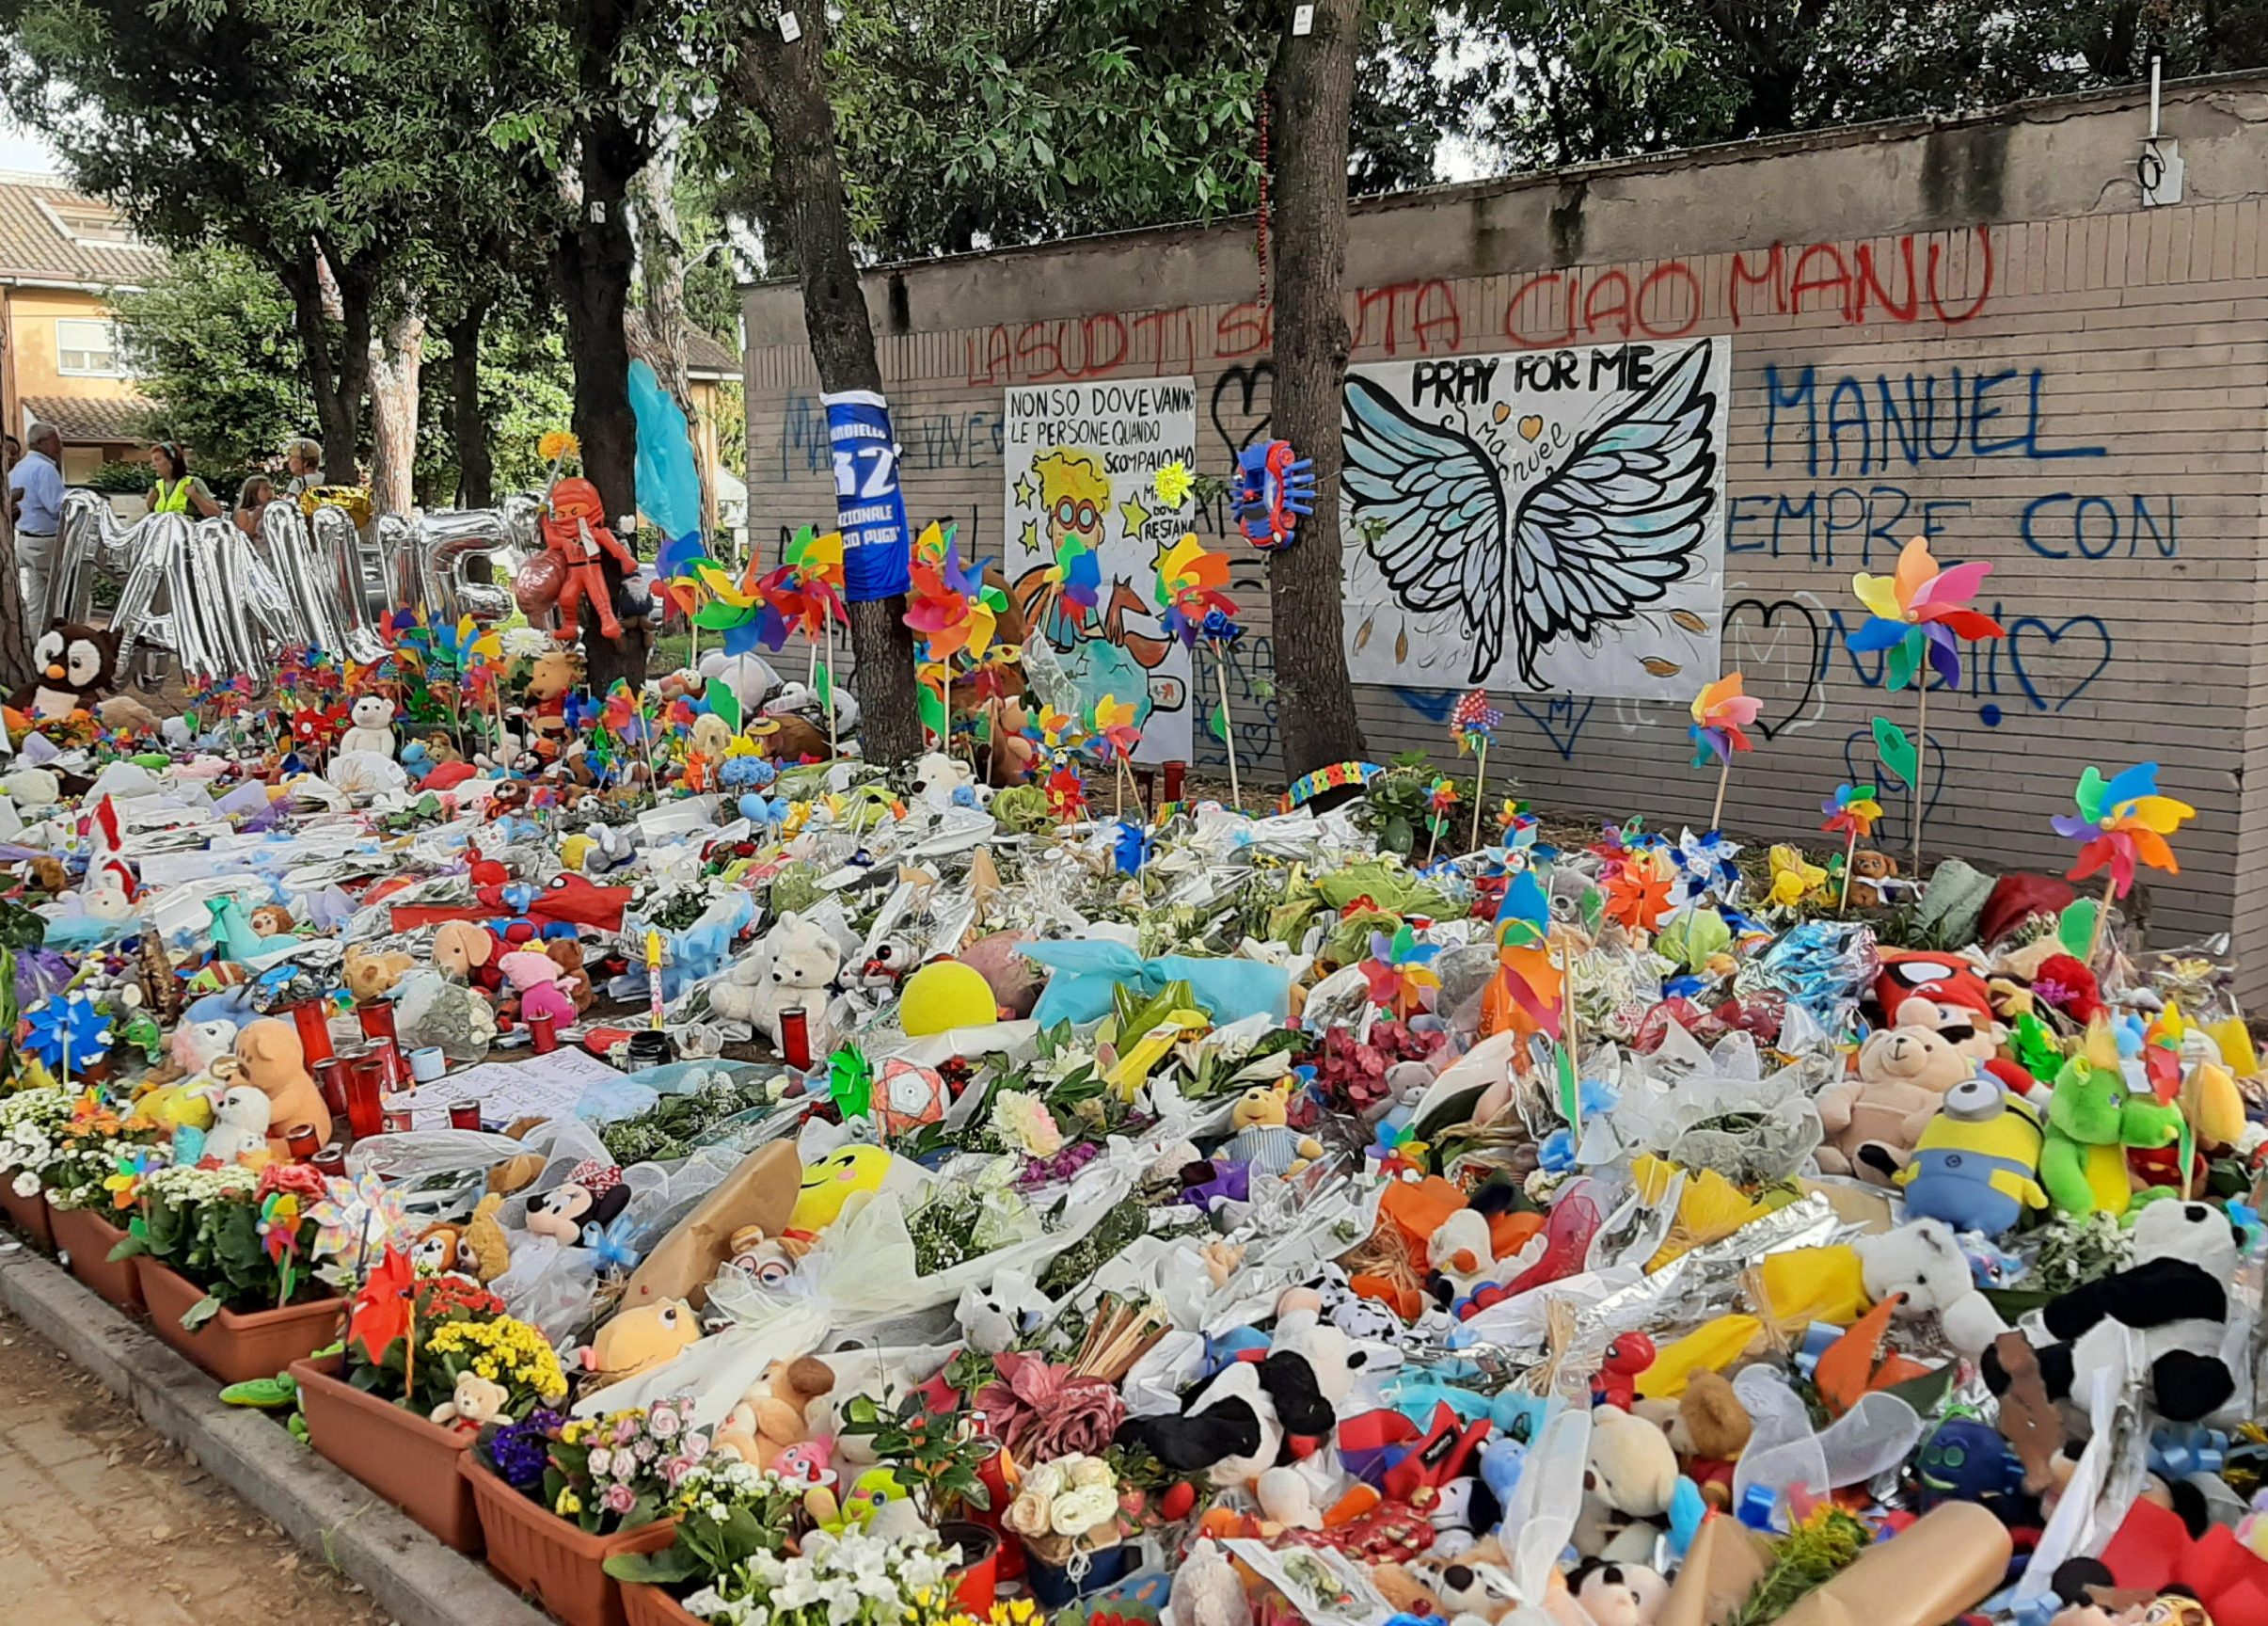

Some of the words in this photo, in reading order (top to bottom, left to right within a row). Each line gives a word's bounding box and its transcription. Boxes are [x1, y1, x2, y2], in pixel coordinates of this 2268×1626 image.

[1505, 262, 1702, 349] CIAO
[1729, 224, 1995, 326] MANU
[1011, 391, 1048, 418] NON
[1052, 389, 1081, 417] SO
[1092, 387, 1149, 417] DOVE
[1413, 356, 1499, 408] PRAY
[1514, 351, 1580, 395] FOR
[1589, 343, 1656, 393] ME
[1011, 422, 1028, 444] LE
[1037, 419, 1110, 447] PERSONE
[1112, 420, 1161, 447] QUANDO
[1765, 363, 2107, 477] MANUEL
[2022, 491, 2181, 560] CON
